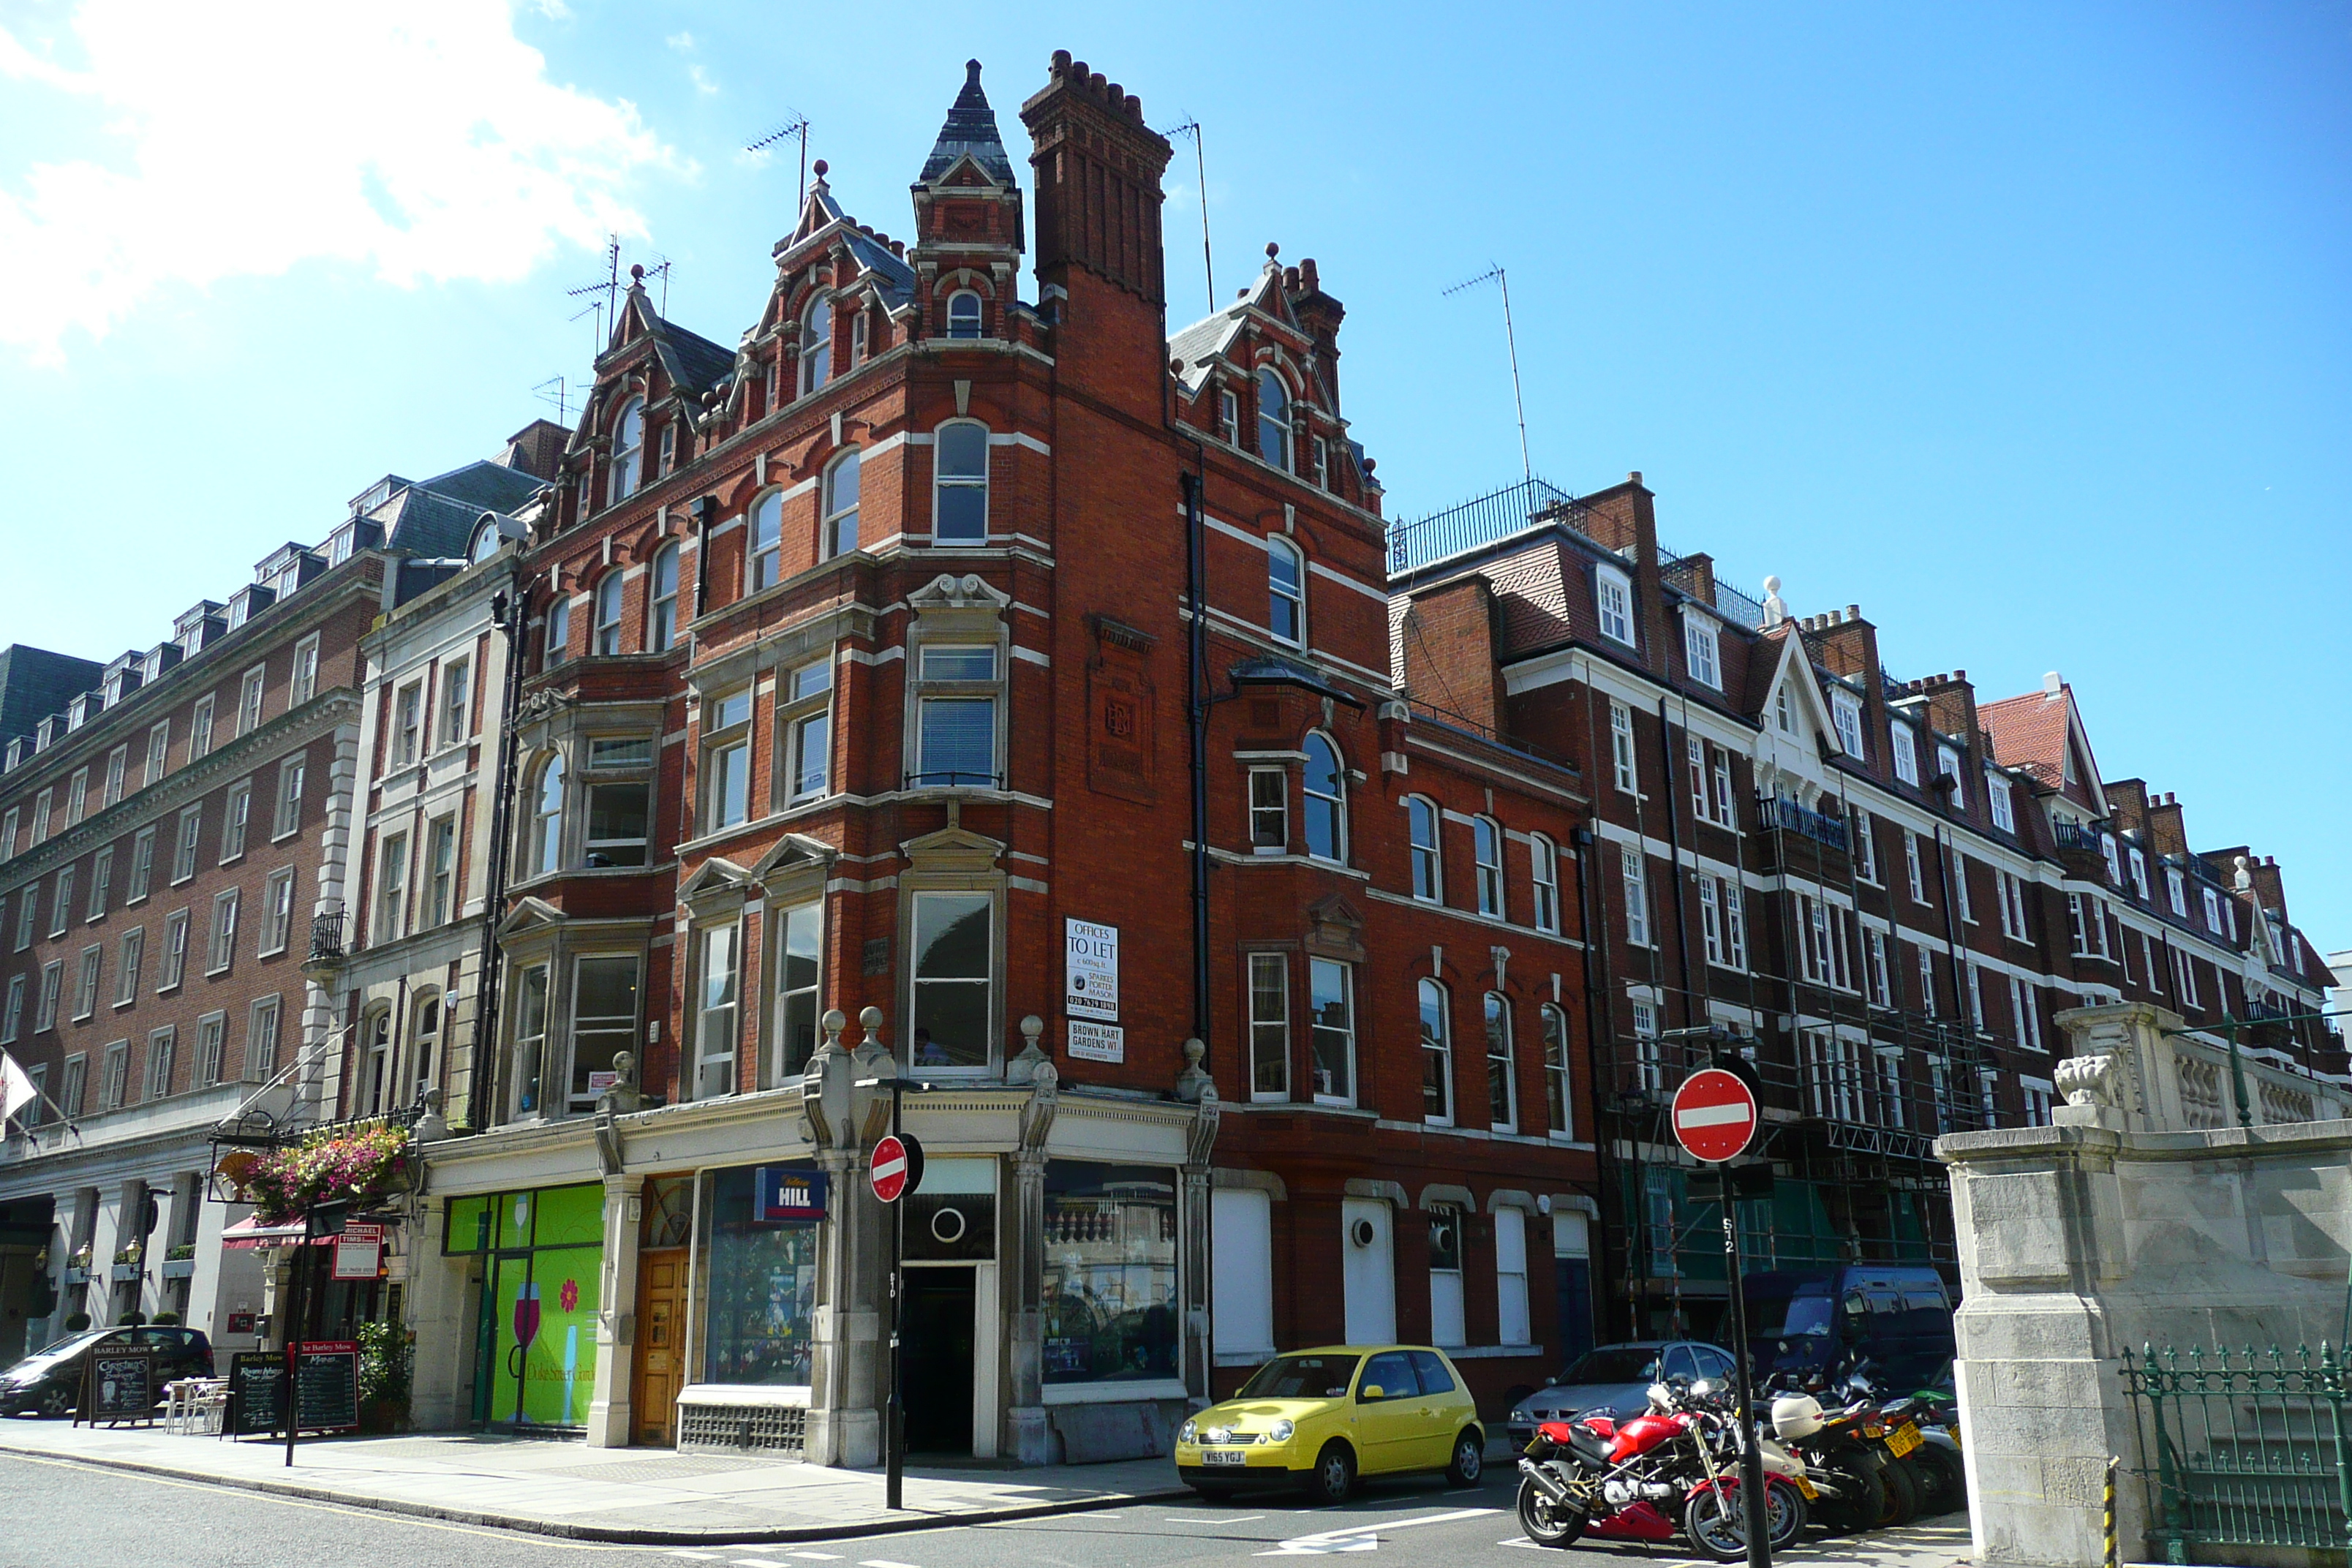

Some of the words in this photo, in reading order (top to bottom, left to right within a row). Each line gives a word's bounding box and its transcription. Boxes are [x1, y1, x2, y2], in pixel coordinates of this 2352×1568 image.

[1074, 923, 1109, 940] OFFICES
[1068, 936, 1088, 954] TO
[1093, 941, 1115, 960] LET
[1088, 972, 1114, 984] SPARKES
[1089, 981, 1113, 991] PORTER
[1088, 988, 1114, 999] MASON
[1069, 996, 1082, 1005] 020
[1073, 1024, 1099, 1037] BROWN
[1101, 1028, 1119, 1040] HART
[1073, 1036, 1105, 1049] GARDENS
[779, 1188, 811, 1207] HILL
[1098, 1199, 1120, 1214] HILL
[1723, 1218, 1735, 1253] S12
[240, 1354, 263, 1363] Barley
[1224, 1452, 1241, 1462] YGJ
